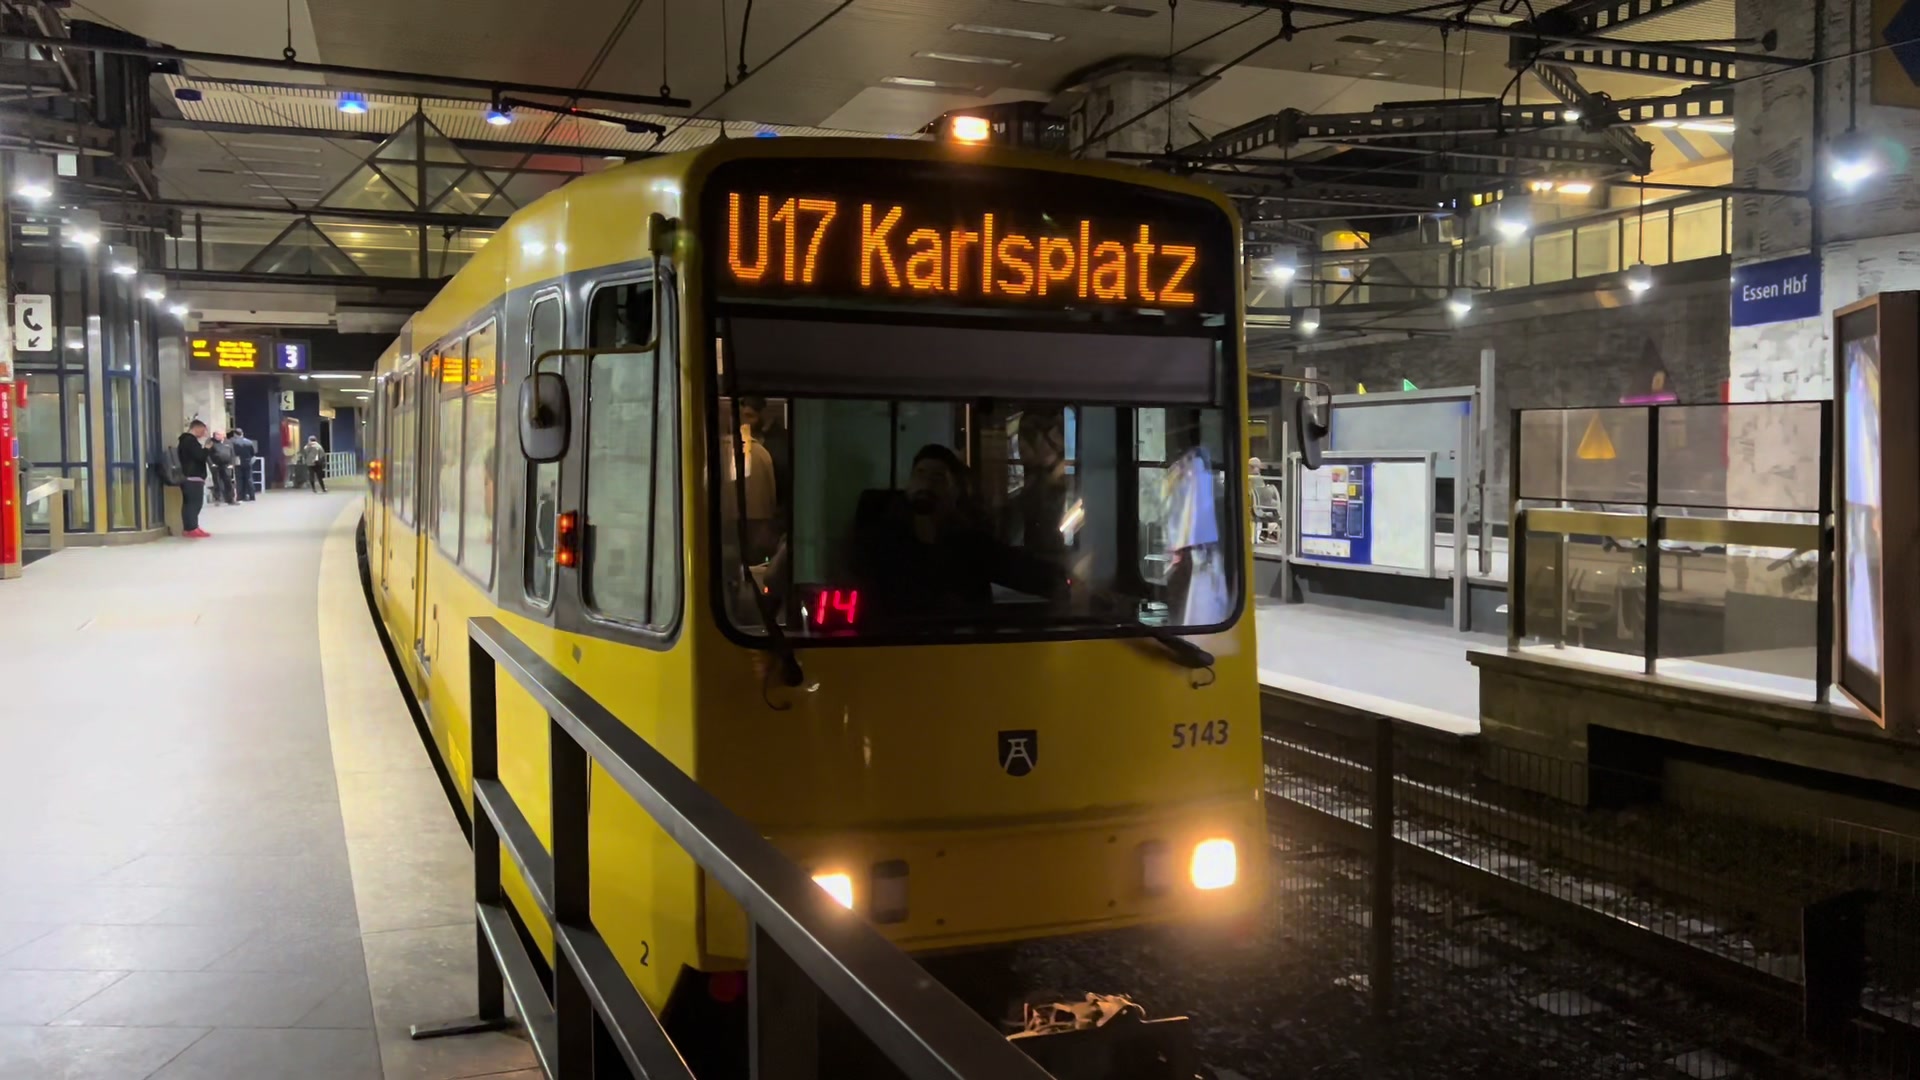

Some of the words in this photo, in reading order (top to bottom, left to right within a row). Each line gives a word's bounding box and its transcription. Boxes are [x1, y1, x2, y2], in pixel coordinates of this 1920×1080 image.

[728, 192, 837, 284] U17
[861, 203, 1197, 303] Karlsplatz
[1742, 283, 1779, 302] Essen
[1783, 273, 1808, 296] Hbf
[285, 350, 298, 369] 3
[816, 590, 858, 624] 14
[1171, 719, 1229, 749] 5143
[639, 940, 649, 967] 2
